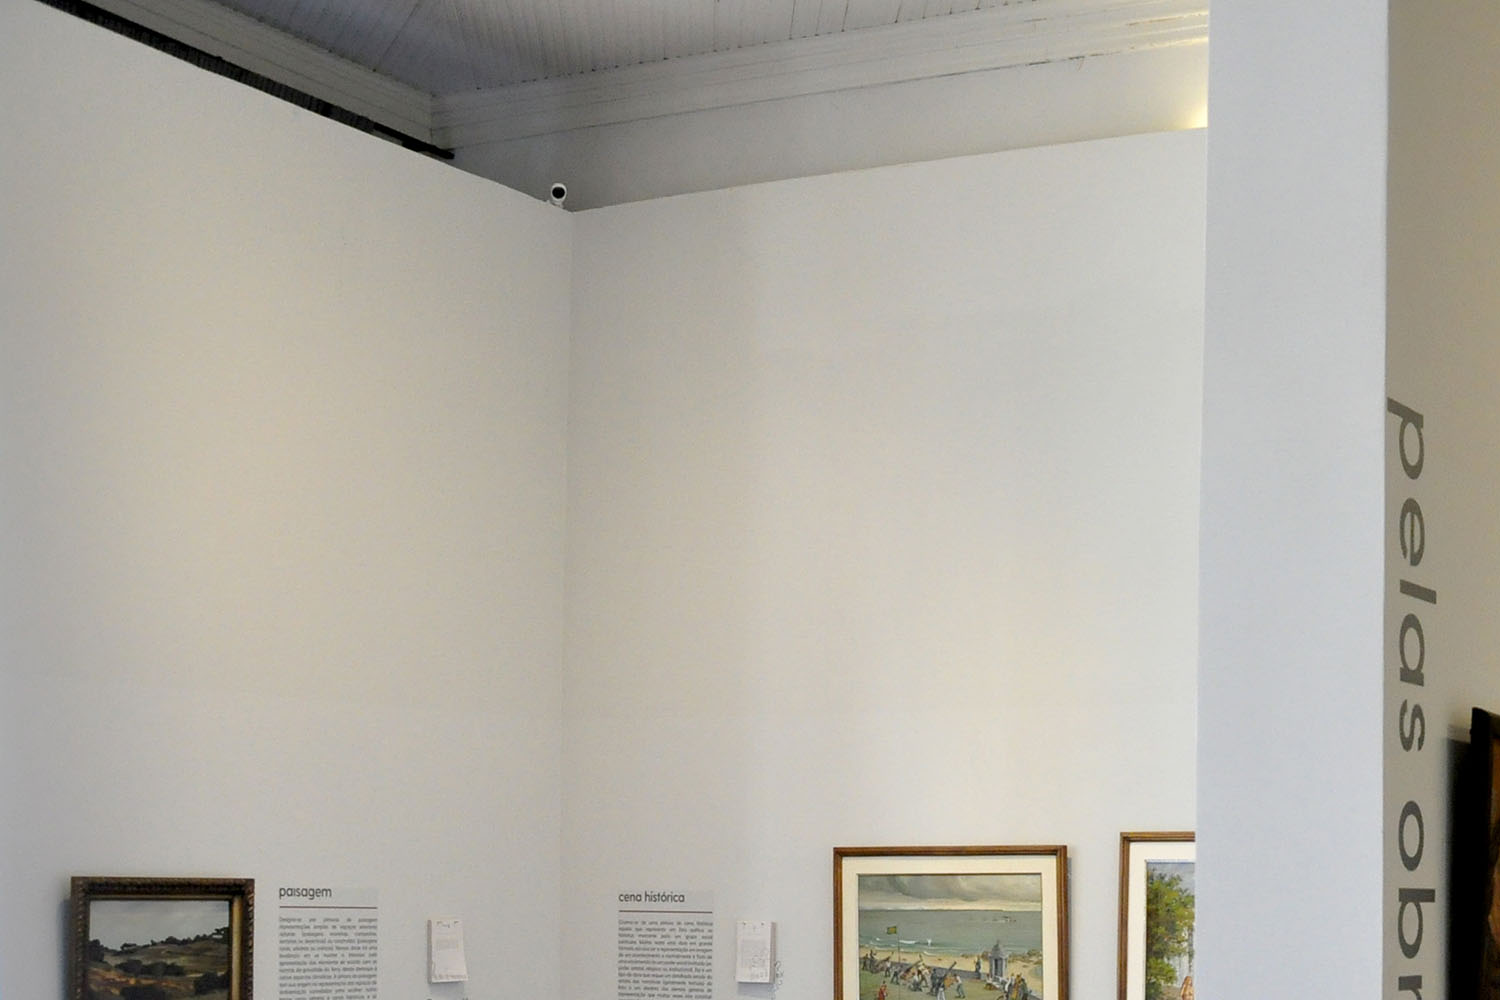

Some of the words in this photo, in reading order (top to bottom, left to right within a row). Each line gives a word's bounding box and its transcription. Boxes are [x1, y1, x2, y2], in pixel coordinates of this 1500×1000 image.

[1387, 397, 1437, 752] pelas
[278, 887, 333, 901] paisagem
[618, 892, 642, 903] cena
[644, 890, 685, 904] histórica
